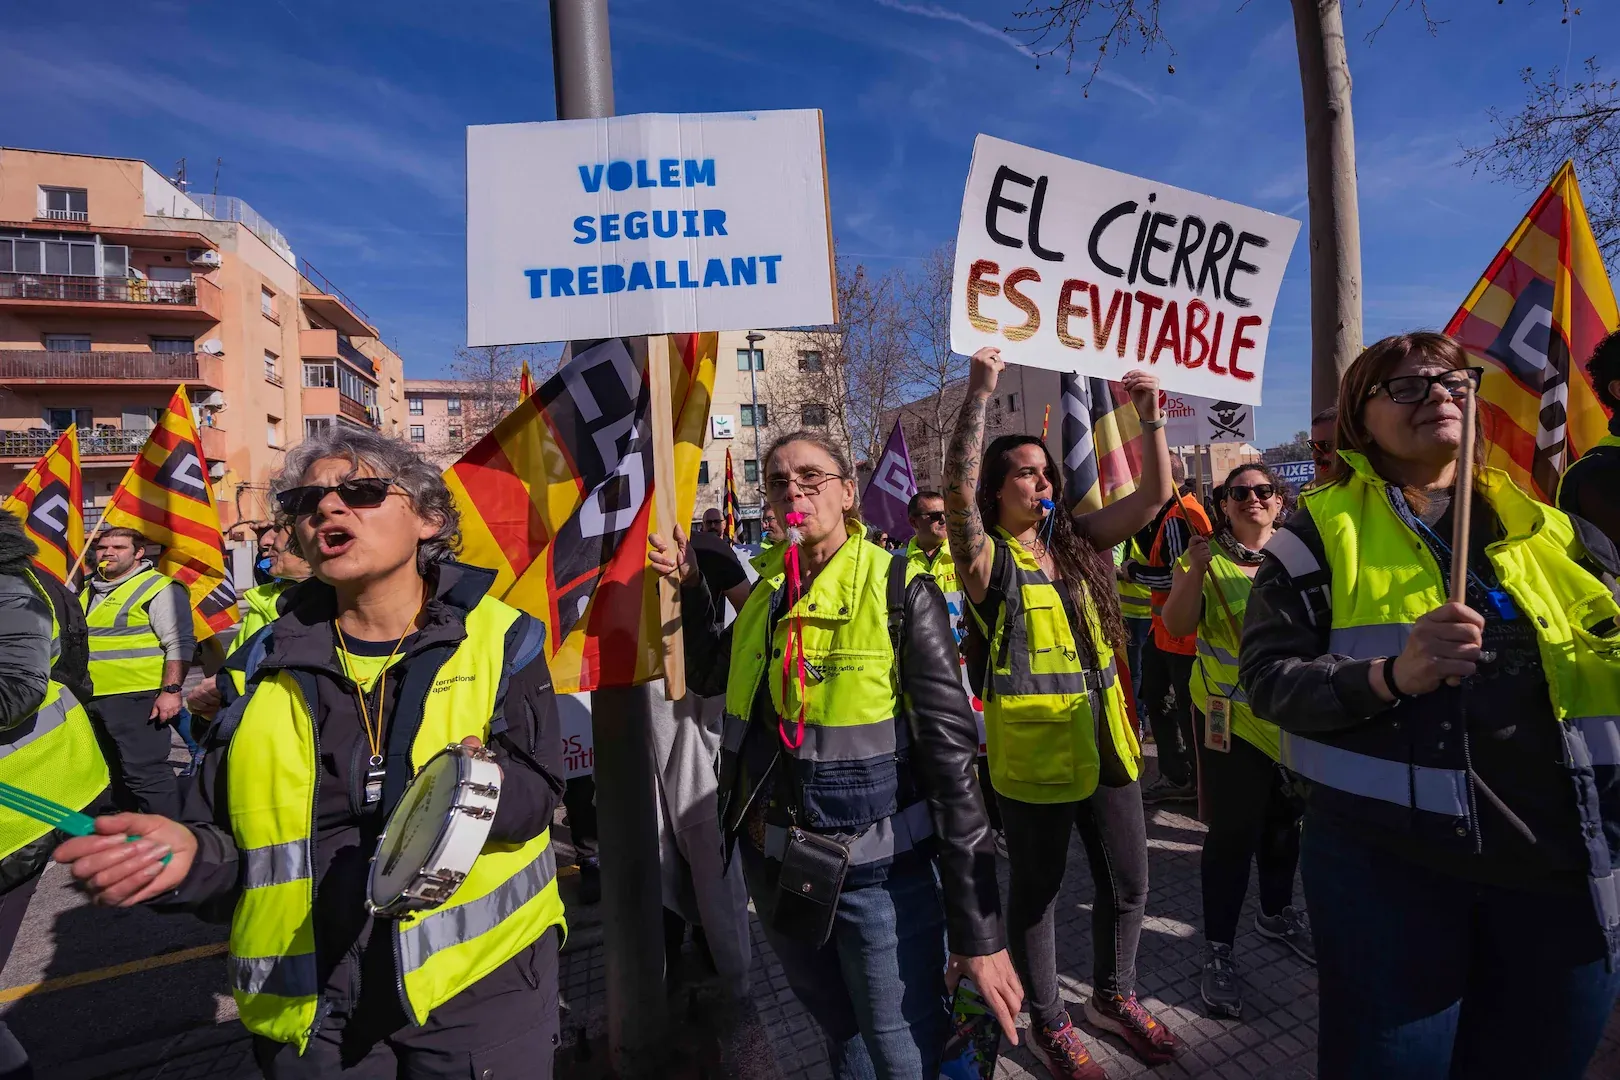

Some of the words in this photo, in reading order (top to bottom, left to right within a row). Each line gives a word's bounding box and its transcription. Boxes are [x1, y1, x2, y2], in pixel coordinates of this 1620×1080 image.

[578, 158, 717, 193] VOLEM
[572, 208, 729, 245] SEGUIR
[985, 164, 1065, 262] EL
[523, 254, 783, 299] TREBALLANT
[966, 258, 1042, 342] ES
[1056, 279, 1262, 383] EVITABLE
[1167, 397, 1184, 409] DS
